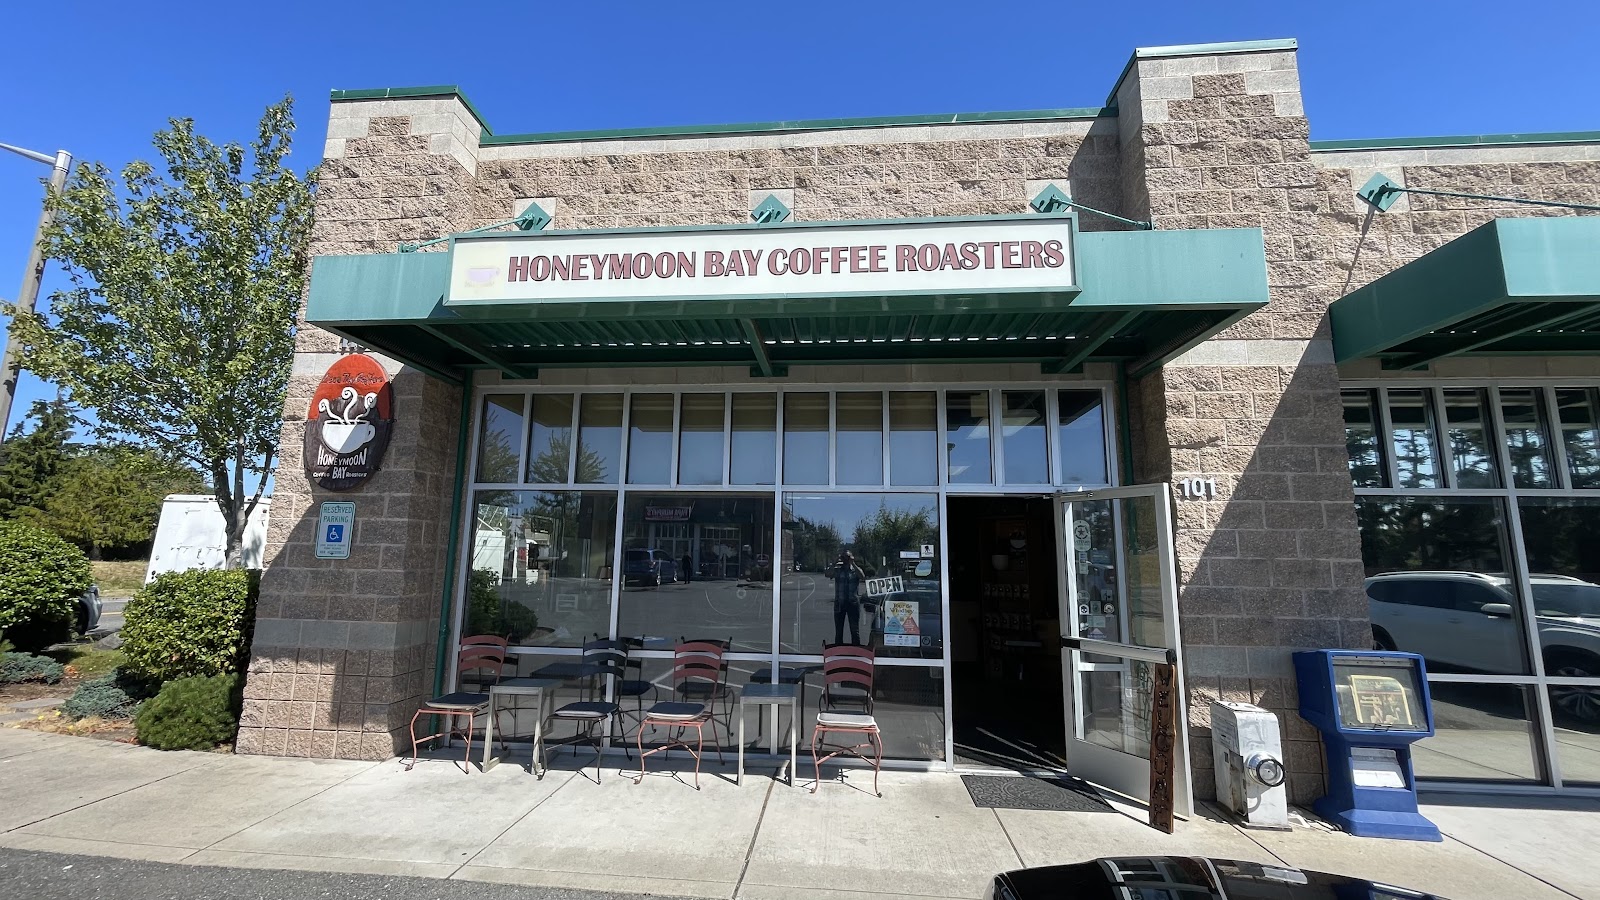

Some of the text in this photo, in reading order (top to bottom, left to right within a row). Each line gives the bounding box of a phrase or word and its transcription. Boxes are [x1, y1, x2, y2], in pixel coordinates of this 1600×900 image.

[508, 239, 1066, 283] HONEYMOON BAY COFFEE ROASTERS
[317, 445, 367, 465] HONEYMOON
[332, 466, 348, 479] BAY
[1180, 478, 1216, 497] 101
[323, 506, 352, 514] RESERVED
[868, 578, 900, 595] OPEN
